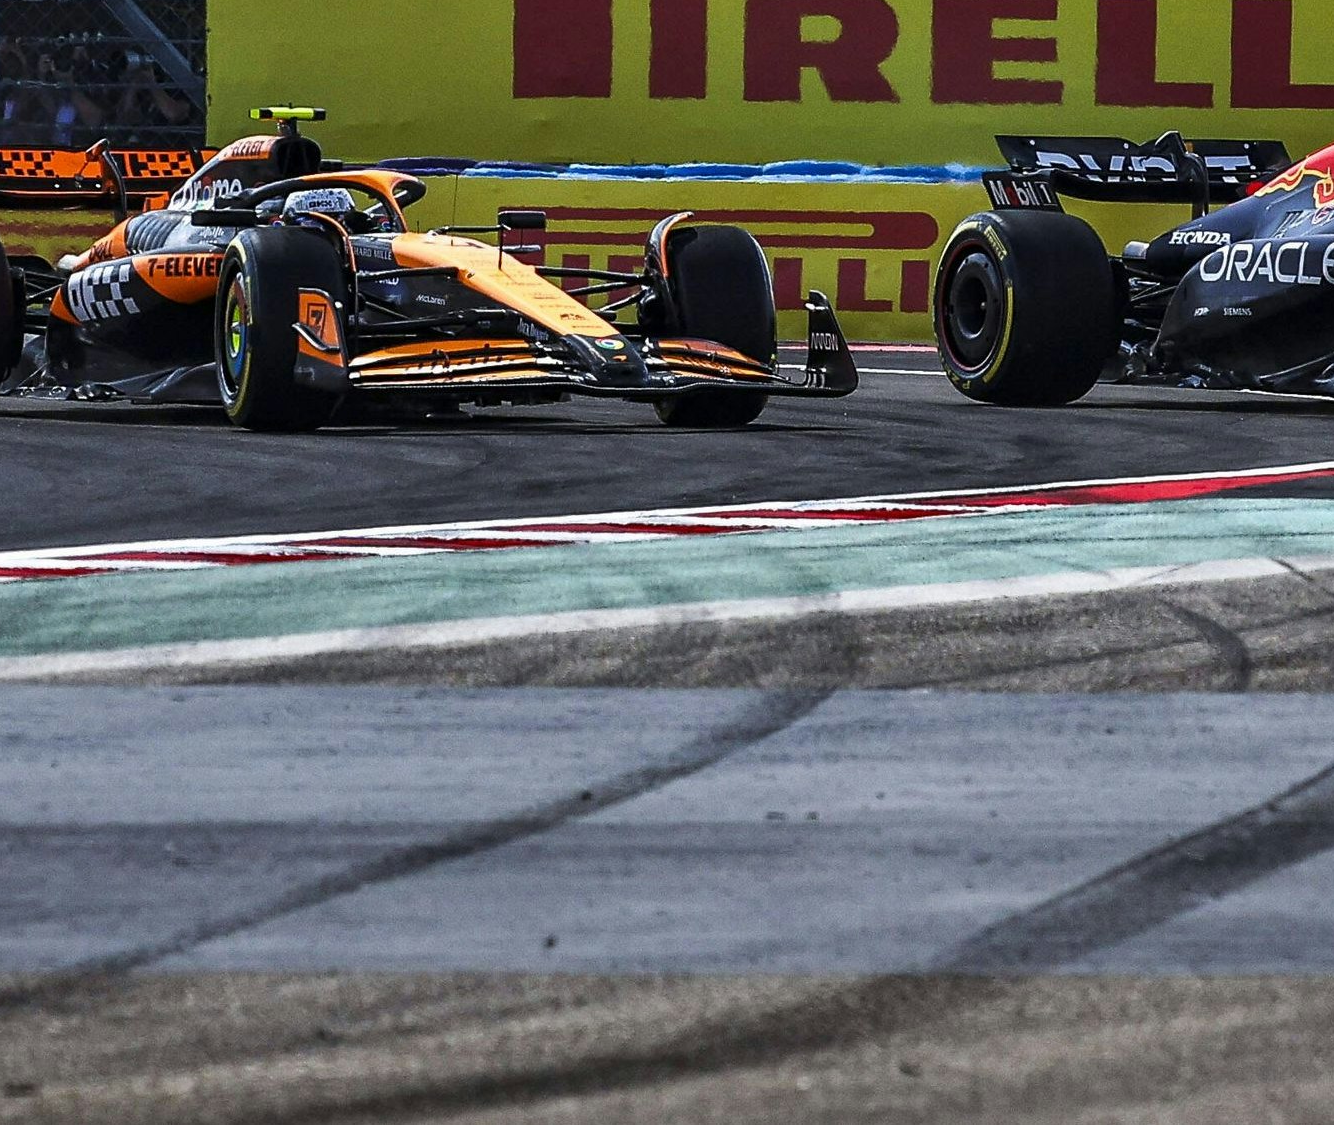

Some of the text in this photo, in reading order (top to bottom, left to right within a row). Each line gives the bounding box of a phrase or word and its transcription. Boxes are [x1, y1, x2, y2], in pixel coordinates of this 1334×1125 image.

[117, 152, 189, 177] KX
[988, 180, 1052, 206] Mobil 1
[308, 199, 333, 208] OKX
[1169, 231, 1231, 246] HONDA
[68, 263, 141, 322] OKX
[416, 294, 446, 306] McLaren
[1223, 307, 1252, 316] SIEMENS
[811, 332, 839, 351] ARROW
